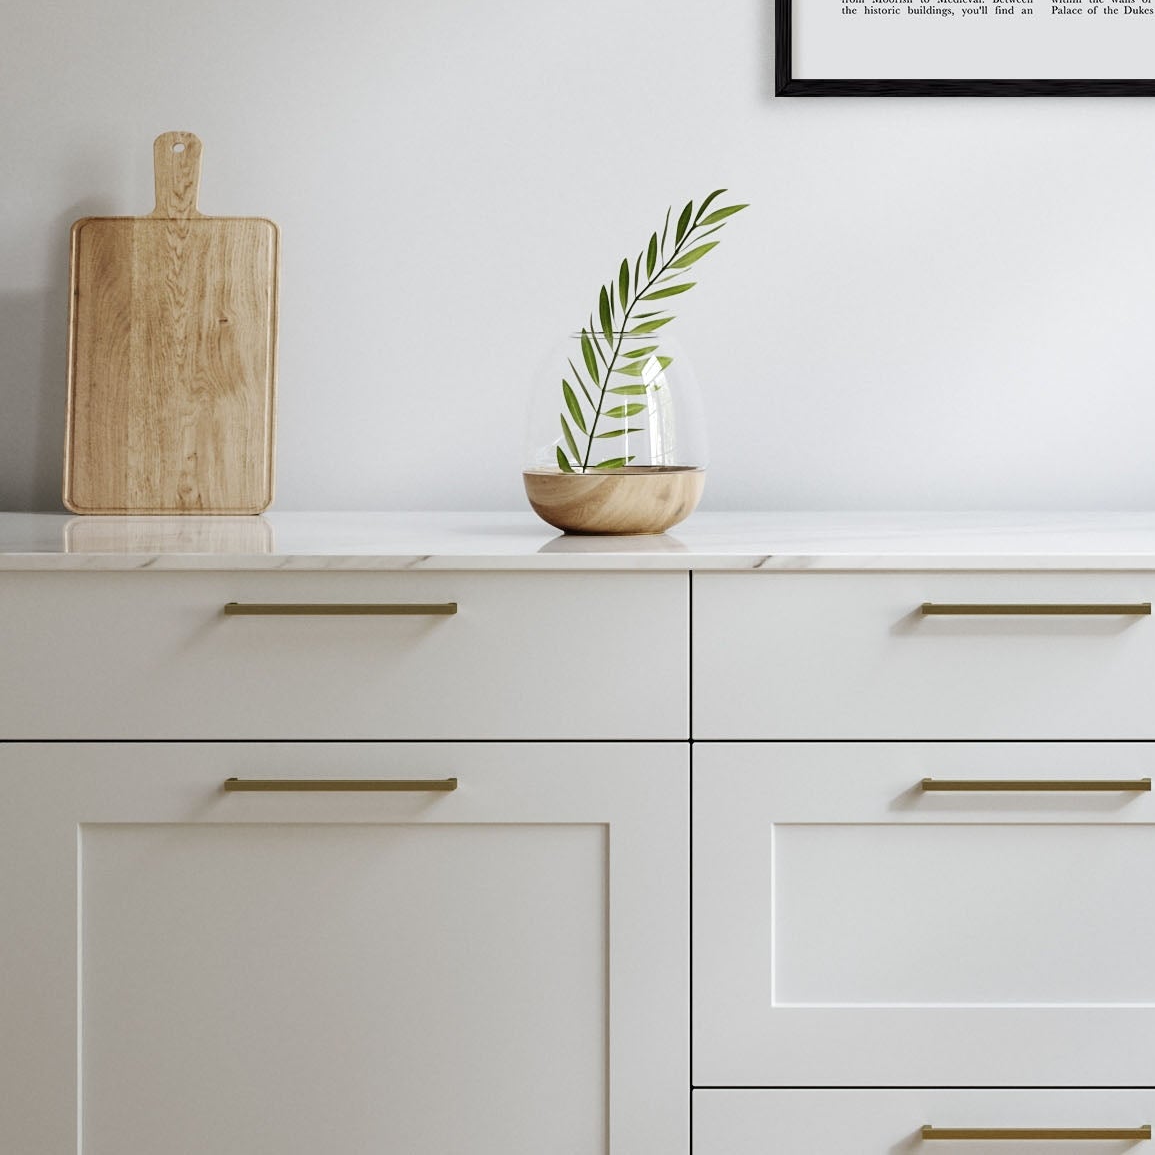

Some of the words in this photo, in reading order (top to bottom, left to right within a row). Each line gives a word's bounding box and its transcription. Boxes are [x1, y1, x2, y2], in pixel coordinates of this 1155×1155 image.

[841, 6, 858, 15] the
[864, 6, 901, 15] historic
[907, 6, 955, 17] buildings,
[961, 6, 988, 17] you'll
[994, 6, 1015, 15] find
